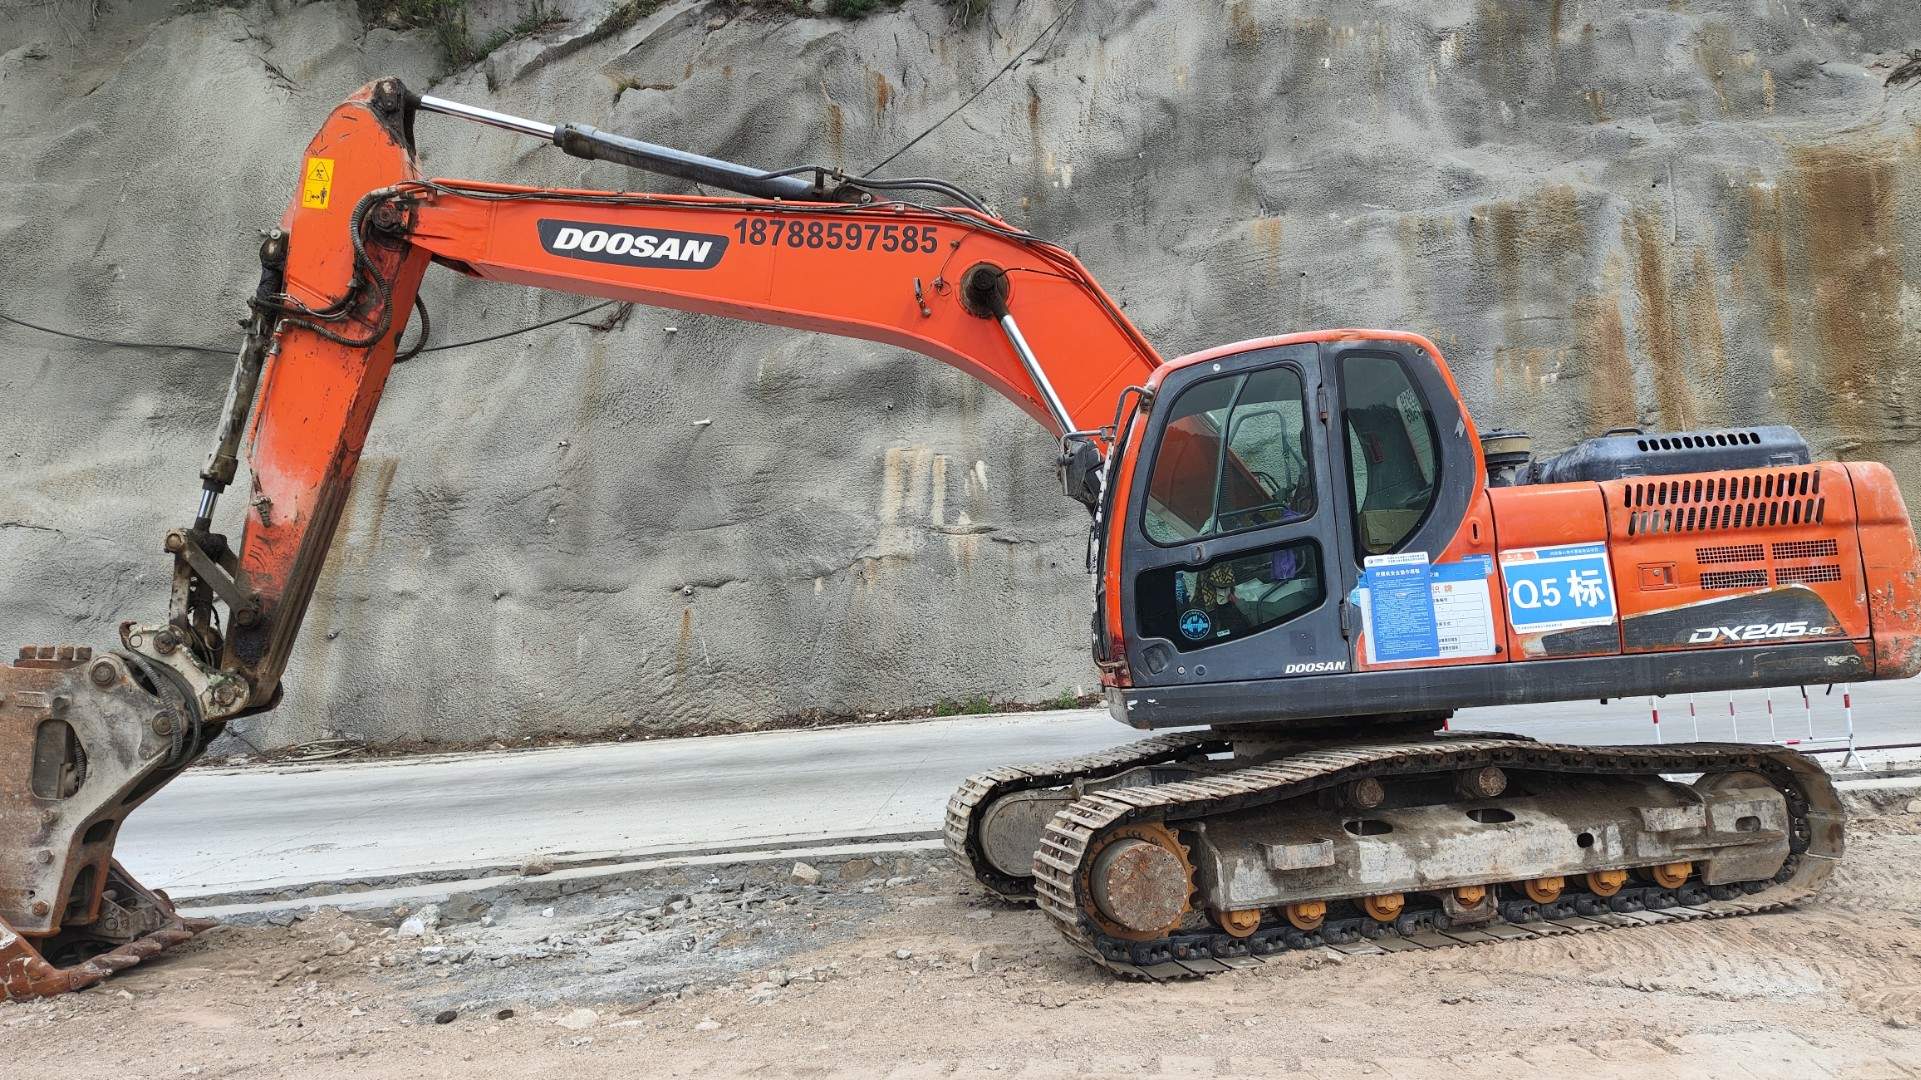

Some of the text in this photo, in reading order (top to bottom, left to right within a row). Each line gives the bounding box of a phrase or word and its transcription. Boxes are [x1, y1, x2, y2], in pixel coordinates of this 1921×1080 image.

[553, 227, 712, 263] DOOSAN
[733, 217, 939, 254] 18788597585
[1512, 569, 1606, 609] Q5 标
[1285, 660, 1346, 674] DOOSAN
